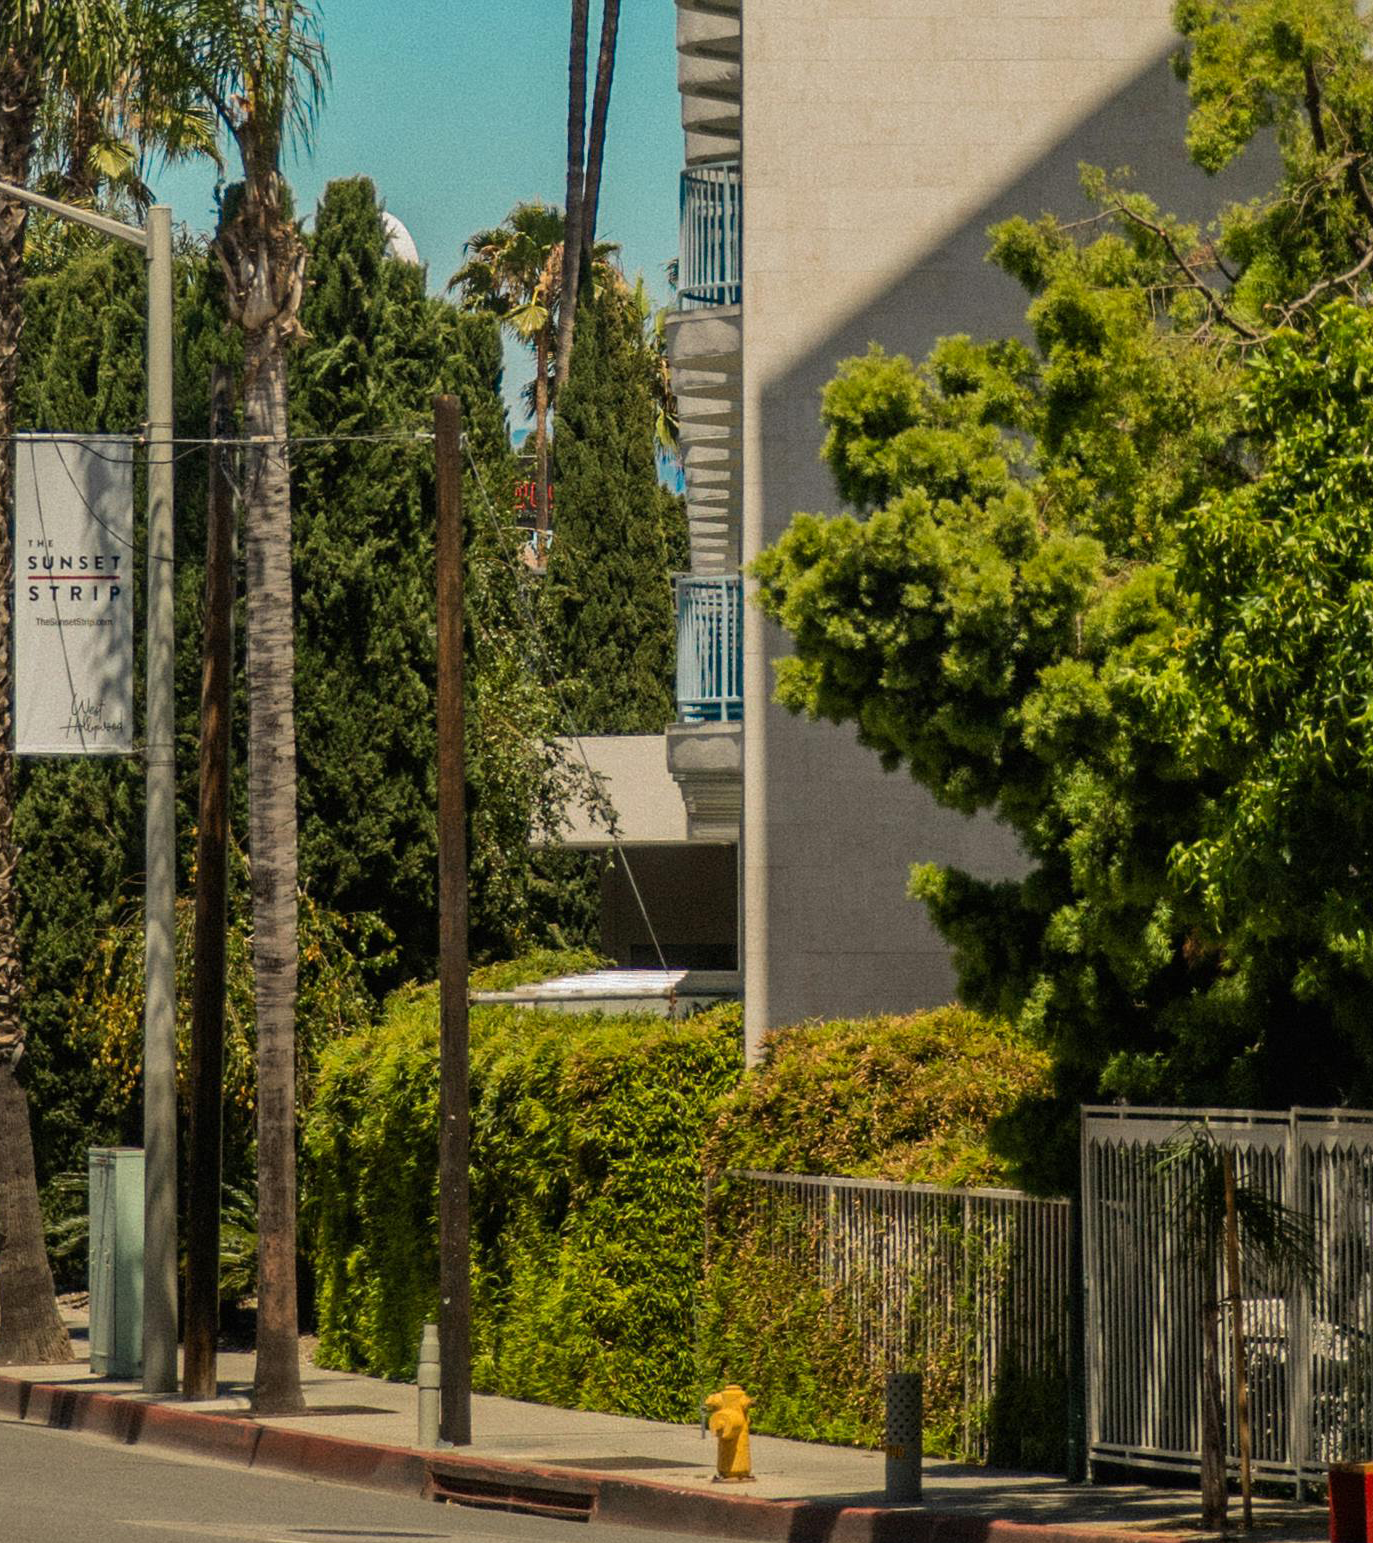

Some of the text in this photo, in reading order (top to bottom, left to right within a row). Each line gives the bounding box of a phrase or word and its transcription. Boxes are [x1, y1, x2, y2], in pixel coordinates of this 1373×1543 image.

[28, 539, 53, 548] THE
[28, 556, 120, 570] SUNSET
[29, 585, 120, 601] STRIP
